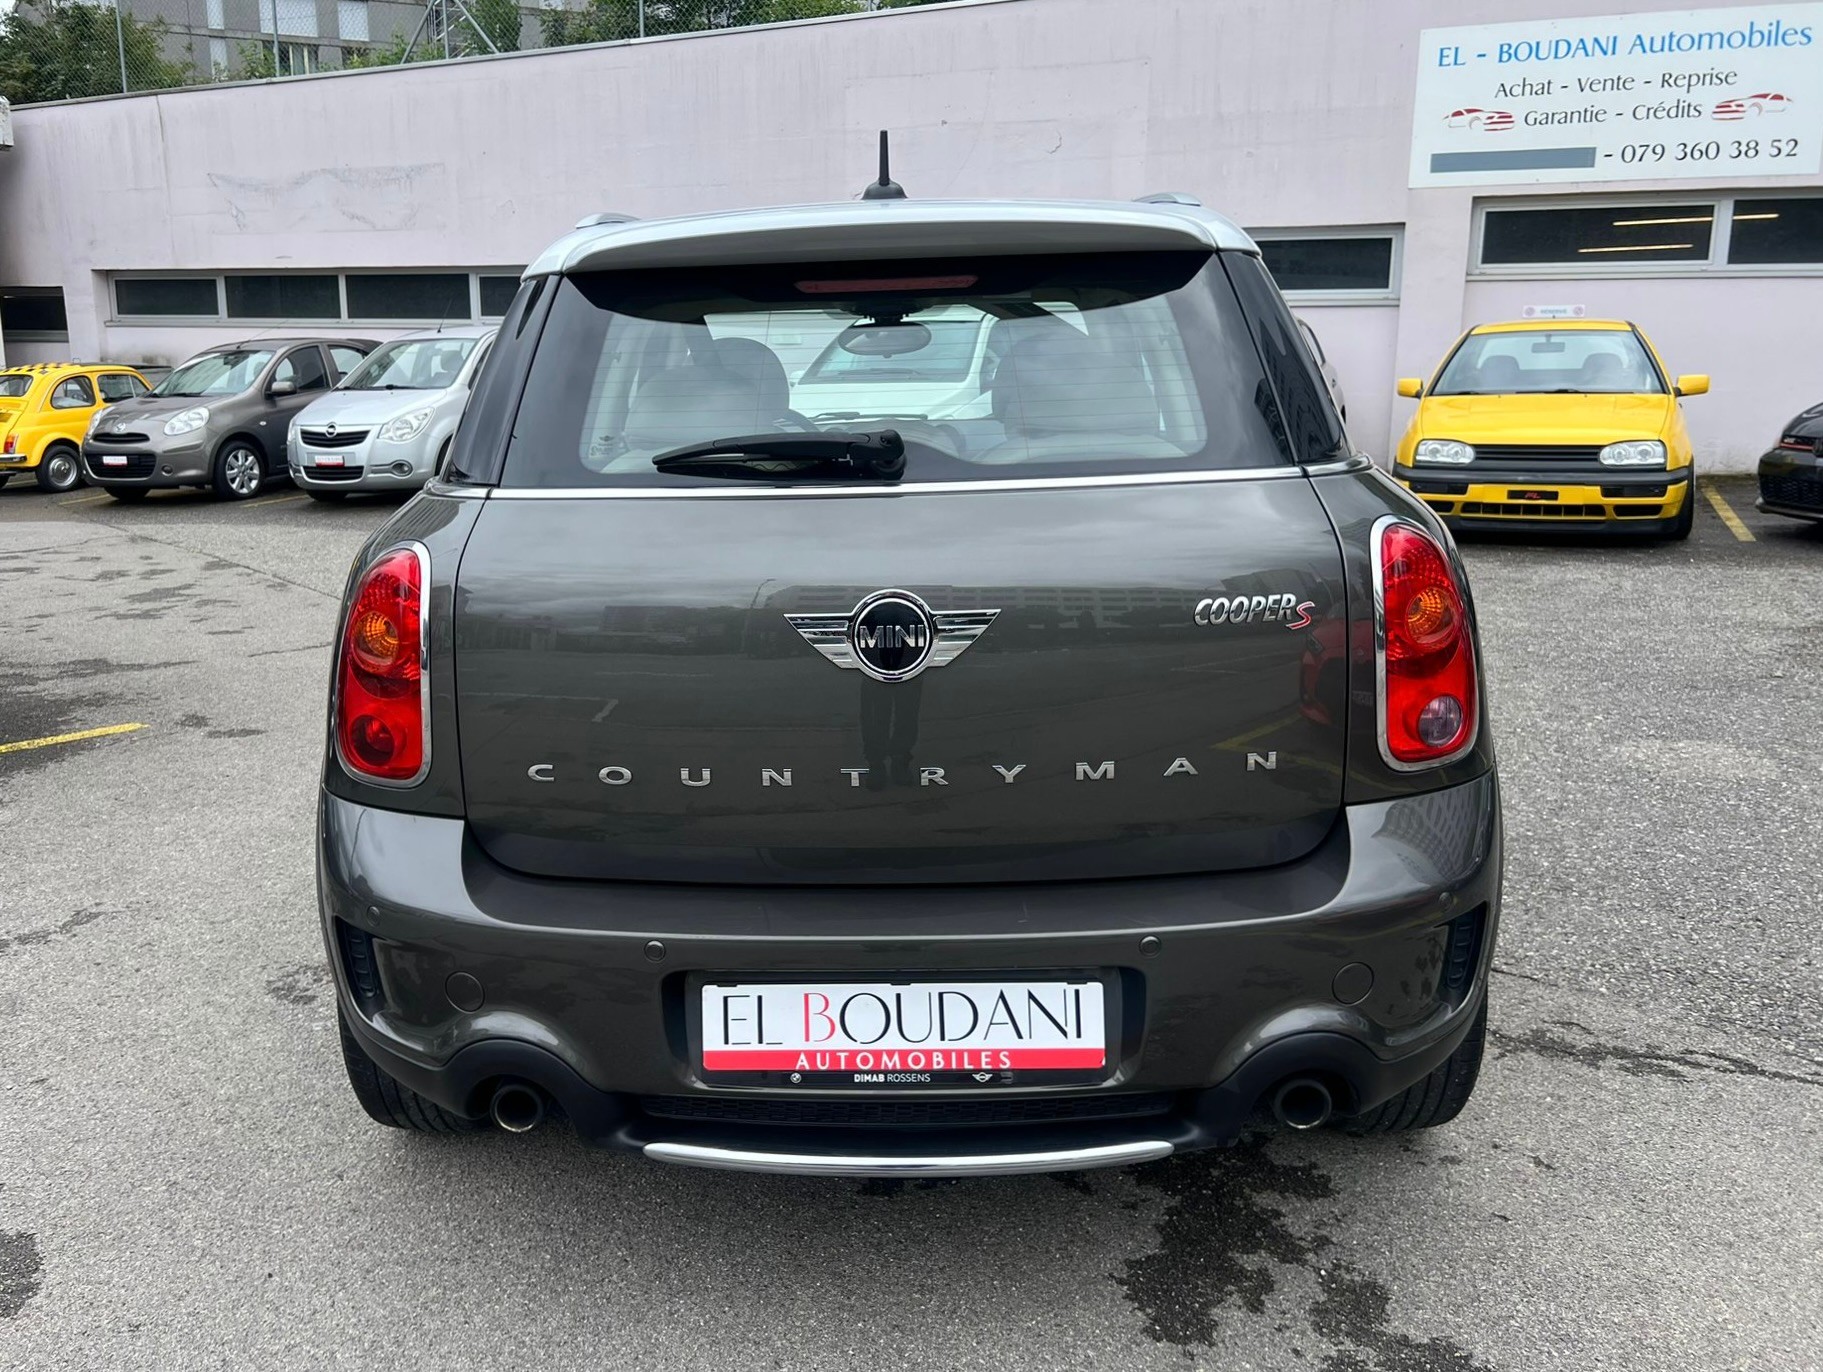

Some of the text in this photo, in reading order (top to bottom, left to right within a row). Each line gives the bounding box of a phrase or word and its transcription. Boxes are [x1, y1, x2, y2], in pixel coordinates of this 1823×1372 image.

[1437, 46, 1466, 67] EL
[1497, 35, 1618, 64] BOUDANI
[1627, 20, 1813, 55] Automobiles
[1494, 77, 1553, 99] Achat
[1577, 74, 1635, 93] Vente
[1660, 67, 1737, 94] Reprise
[1524, 105, 1607, 126] Garantie
[1632, 98, 1703, 121] Crédits
[1621, 143, 1666, 164] 079
[1674, 141, 1720, 161] 360
[1728, 139, 1759, 159] 38
[1768, 138, 1799, 158] 52
[1194, 593, 1316, 630] COOPER S
[860, 624, 924, 649] MINI
[527, 751, 1277, 787] COUNTRYMAN
[723, 988, 1082, 1045] EL BOUDANI
[794, 1051, 1011, 1070] AUTOMOBILES
[854, 1073, 931, 1083] DIMAB ROSSENS
